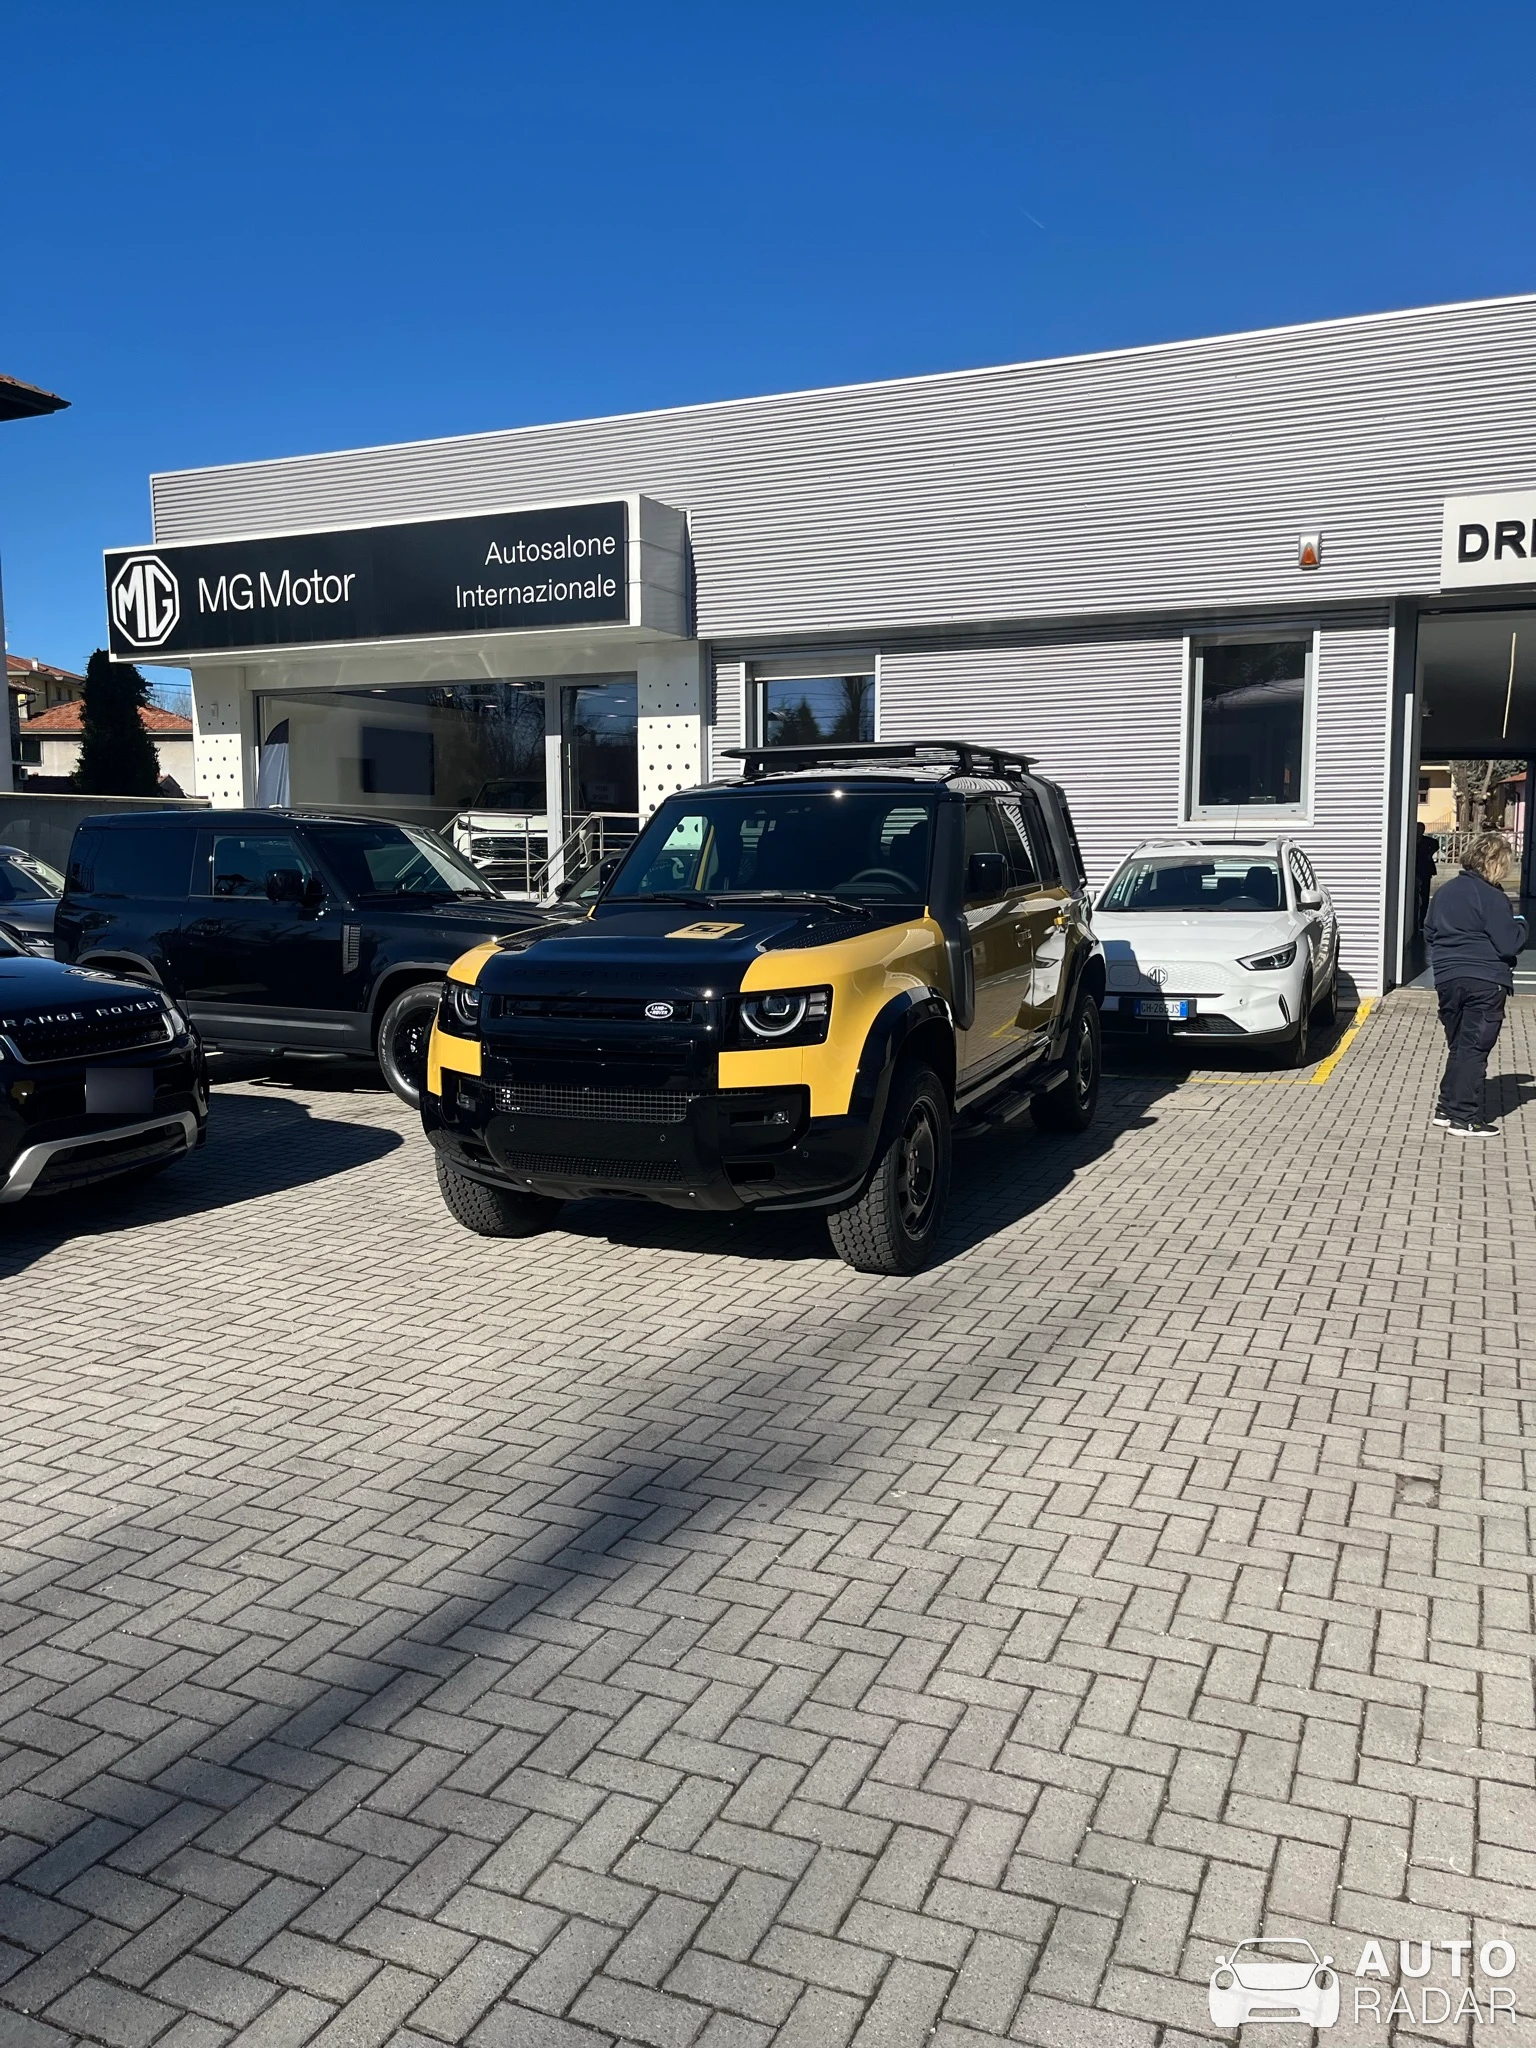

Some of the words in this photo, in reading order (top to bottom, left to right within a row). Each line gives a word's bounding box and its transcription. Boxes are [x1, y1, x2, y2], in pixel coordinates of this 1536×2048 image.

[485, 535, 616, 566] Autosalone
[118, 562, 174, 641] MG
[198, 573, 254, 613] MG
[259, 568, 356, 609] Motor
[456, 574, 617, 609] Internazionale
[1149, 968, 1166, 985] MG
[2, 1012, 84, 1028] RANGE
[96, 1001, 159, 1017] ROVER
